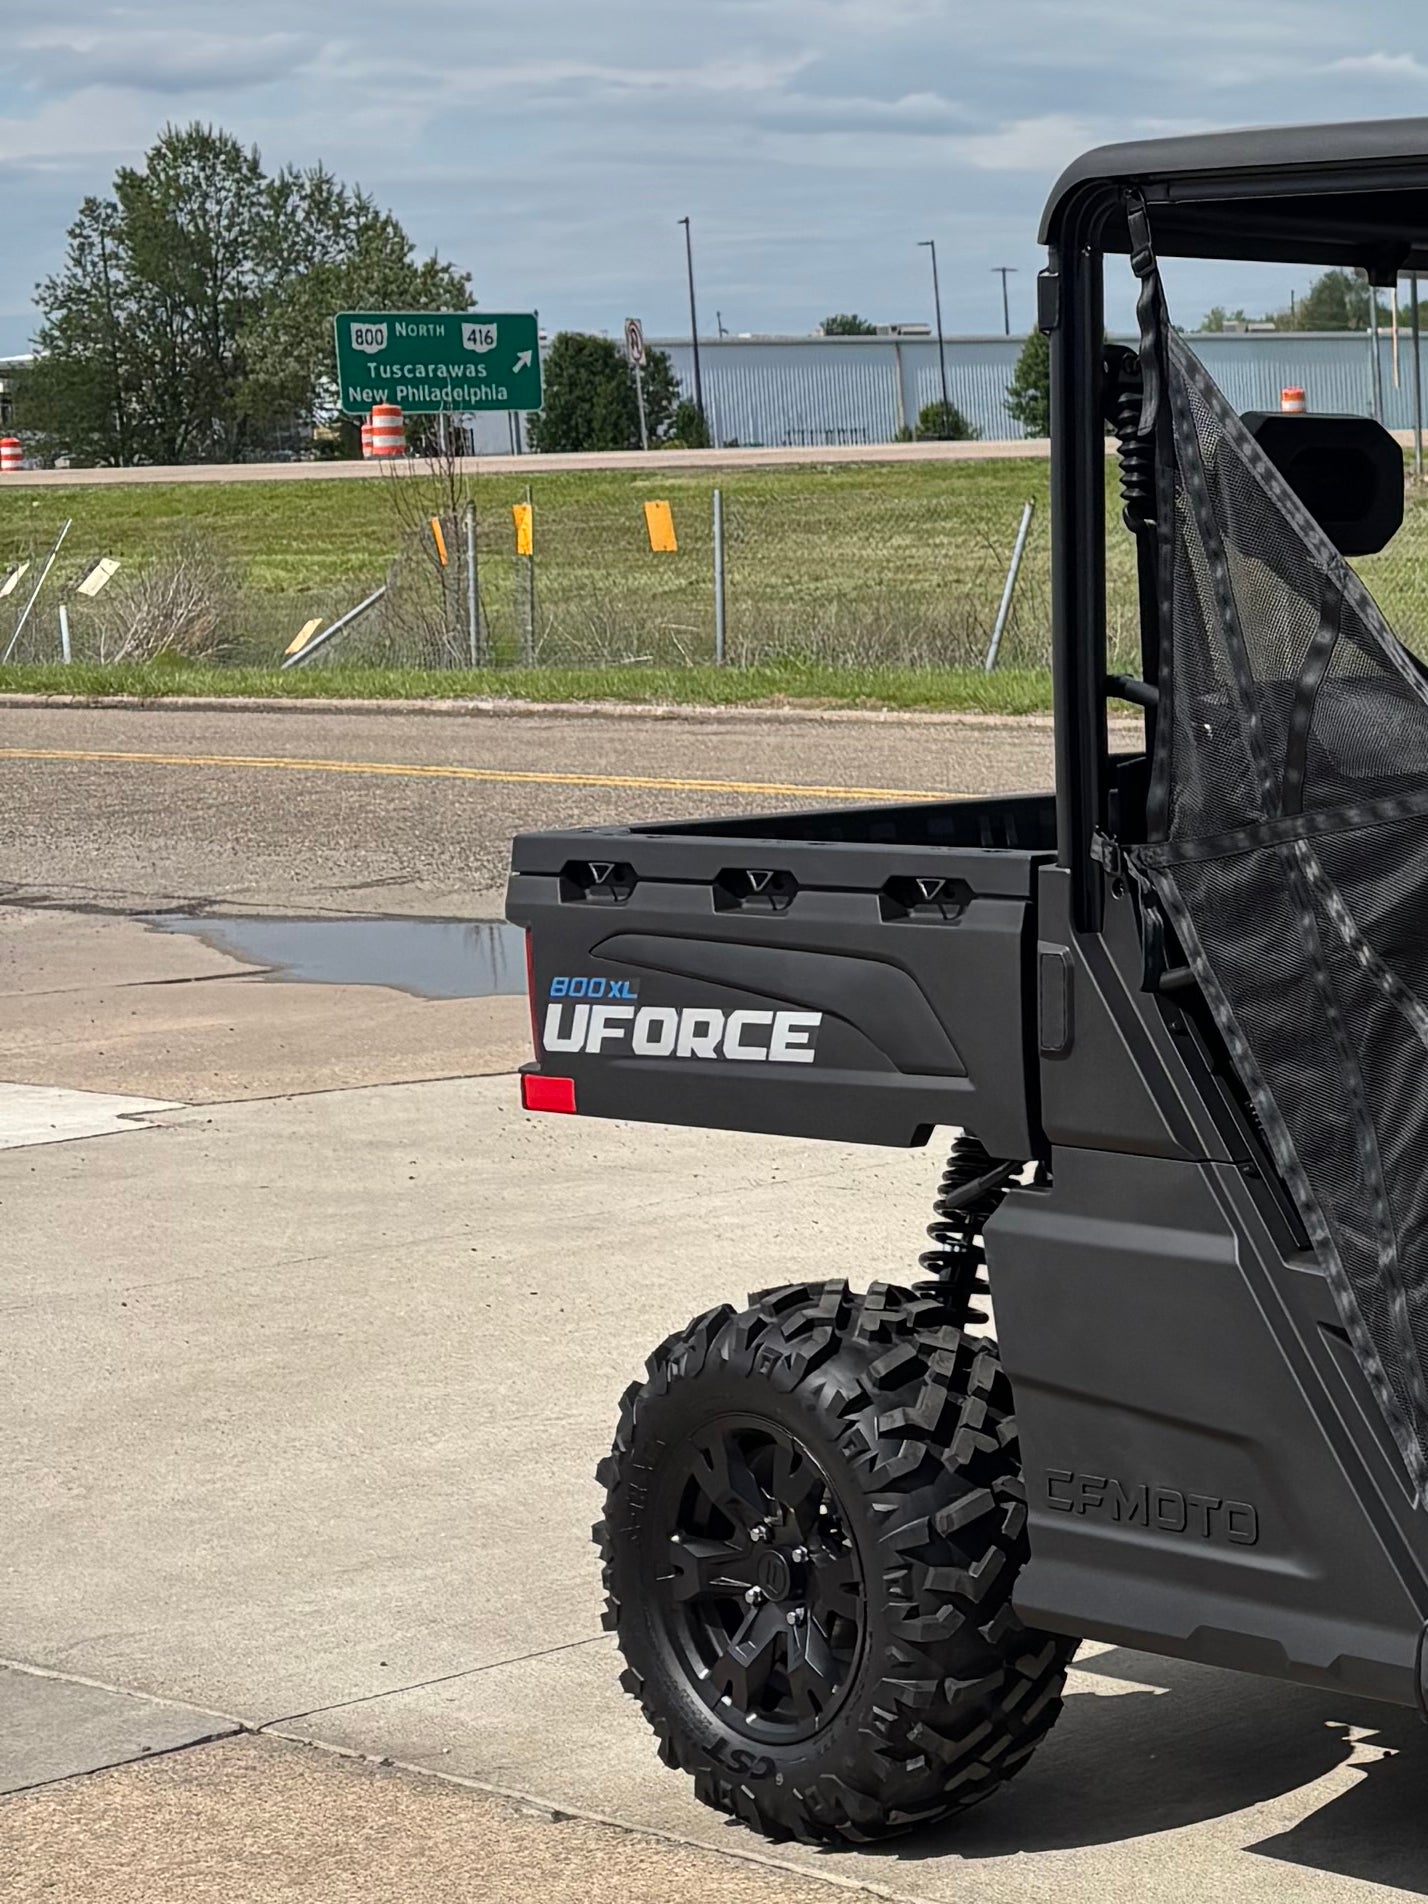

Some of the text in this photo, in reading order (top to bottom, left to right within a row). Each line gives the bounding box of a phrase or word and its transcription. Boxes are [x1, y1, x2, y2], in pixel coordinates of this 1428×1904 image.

[355, 322, 494, 347] 800 NORTH 416
[367, 362, 488, 378] Tuscarawas
[348, 384, 508, 404] New Philadelphia
[542, 1003, 823, 1064] UFORCE
[1045, 1468, 1260, 1546] CFMOTO
[701, 1736, 777, 1781] CST
